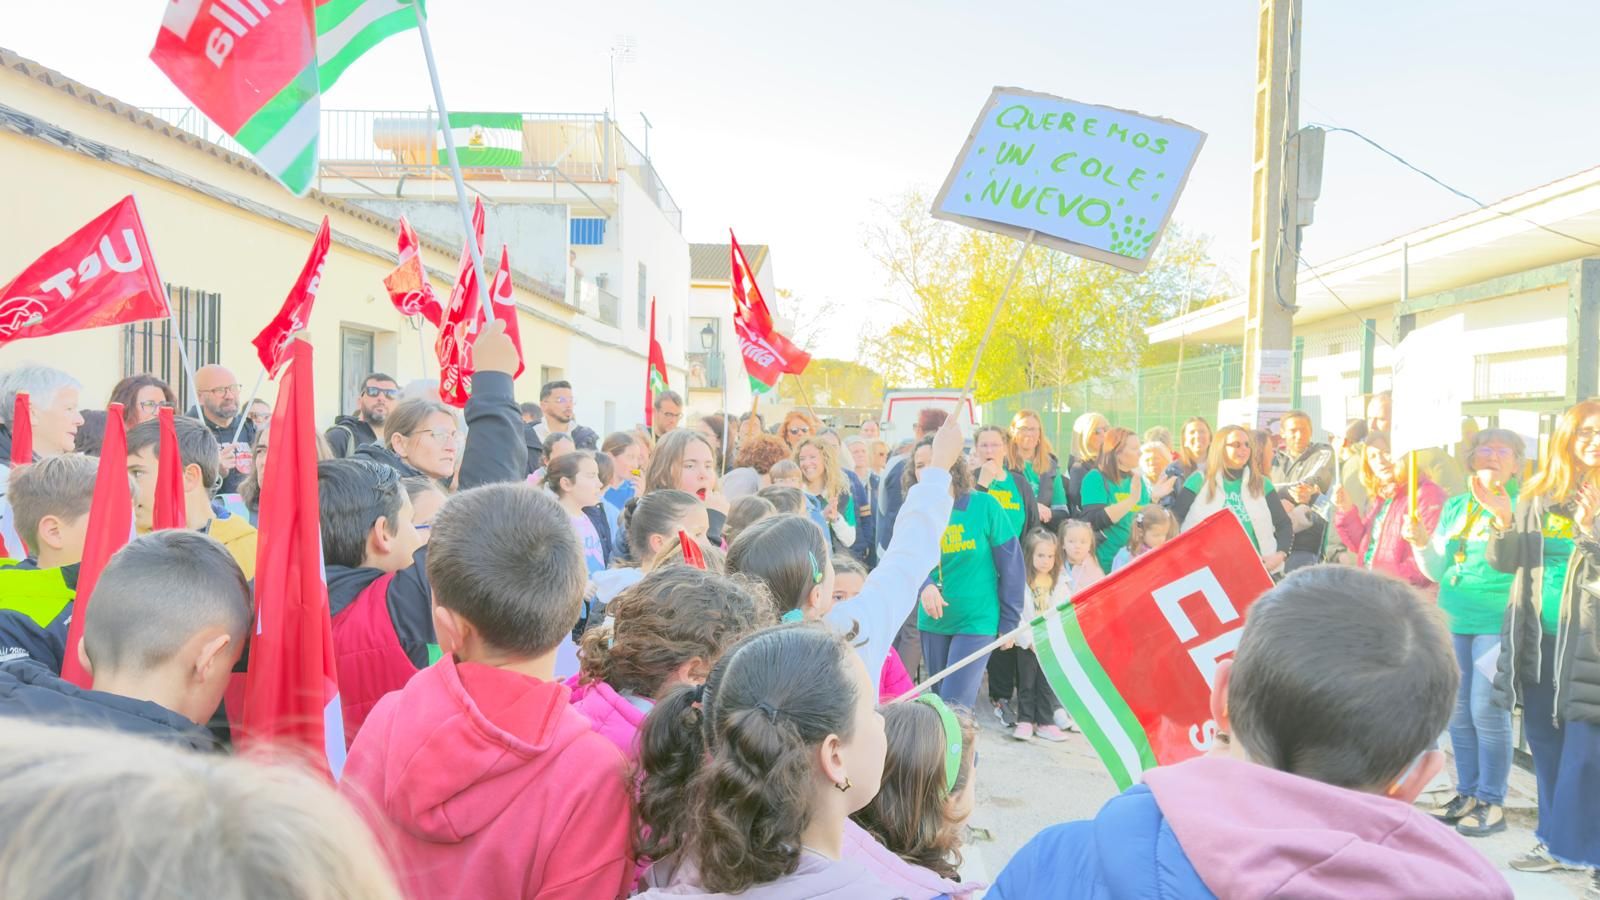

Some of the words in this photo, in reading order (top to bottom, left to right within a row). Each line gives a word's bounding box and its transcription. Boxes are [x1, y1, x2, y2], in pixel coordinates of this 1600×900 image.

[996, 104, 1169, 155] QUEREMOS
[996, 142, 1036, 166] UN
[1051, 152, 1147, 191] COLE
[981, 176, 1112, 227] NUEVO
